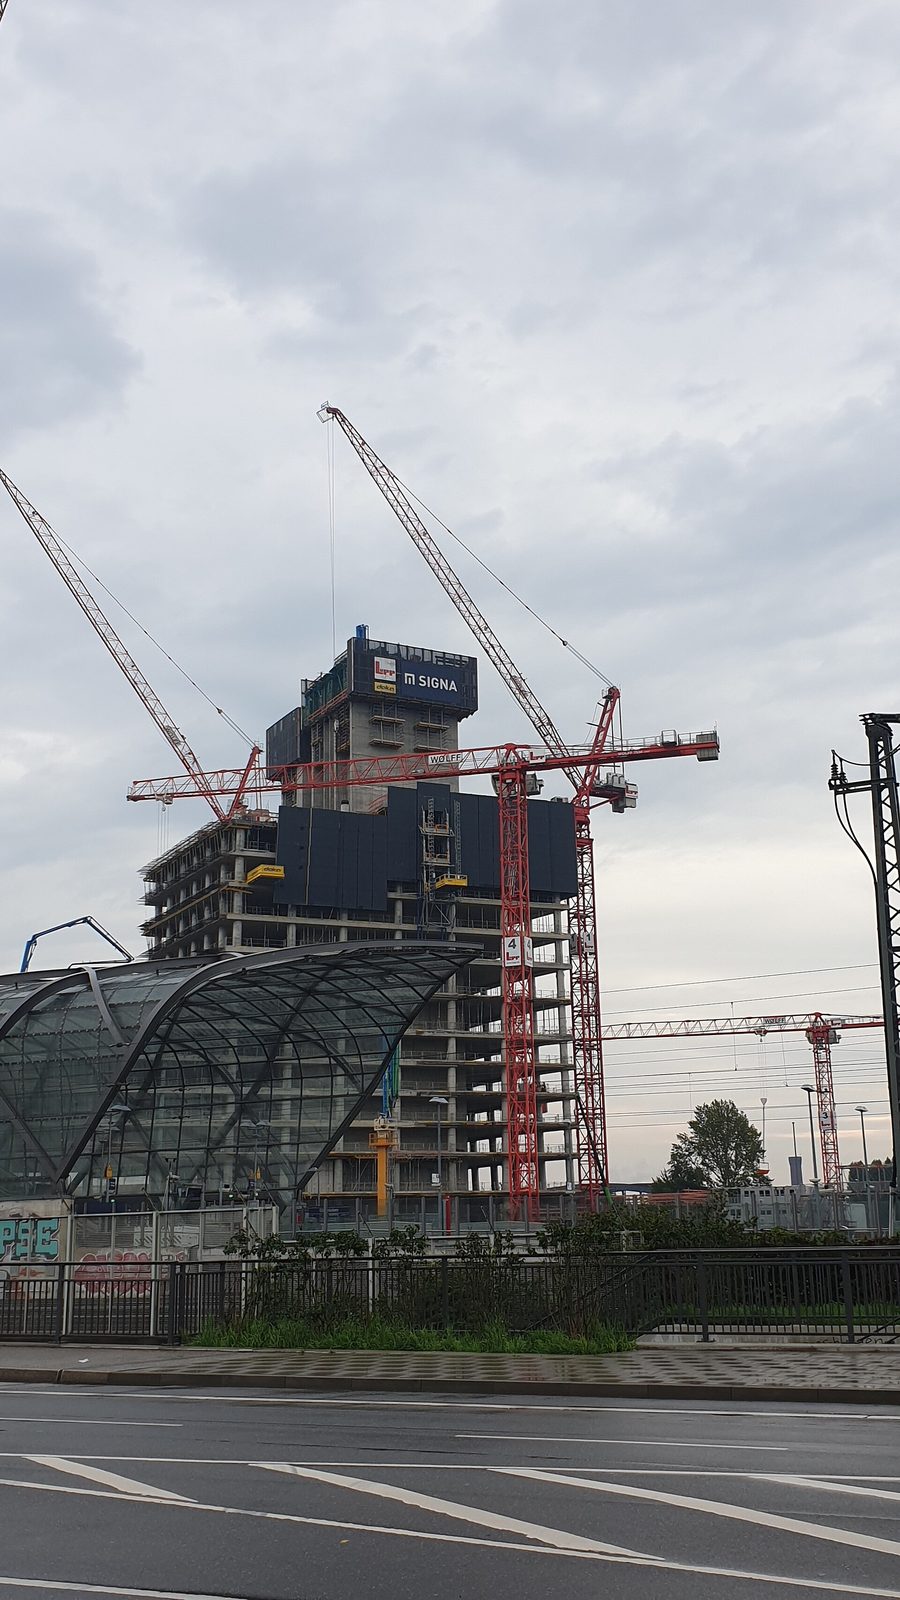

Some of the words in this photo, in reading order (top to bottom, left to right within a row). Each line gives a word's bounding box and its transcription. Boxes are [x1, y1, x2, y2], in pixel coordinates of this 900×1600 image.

[419, 675, 458, 692] SIGNA
[507, 938, 517, 949] 4
[527, 939, 532, 950] 4
[822, 1111, 829, 1119] 3
